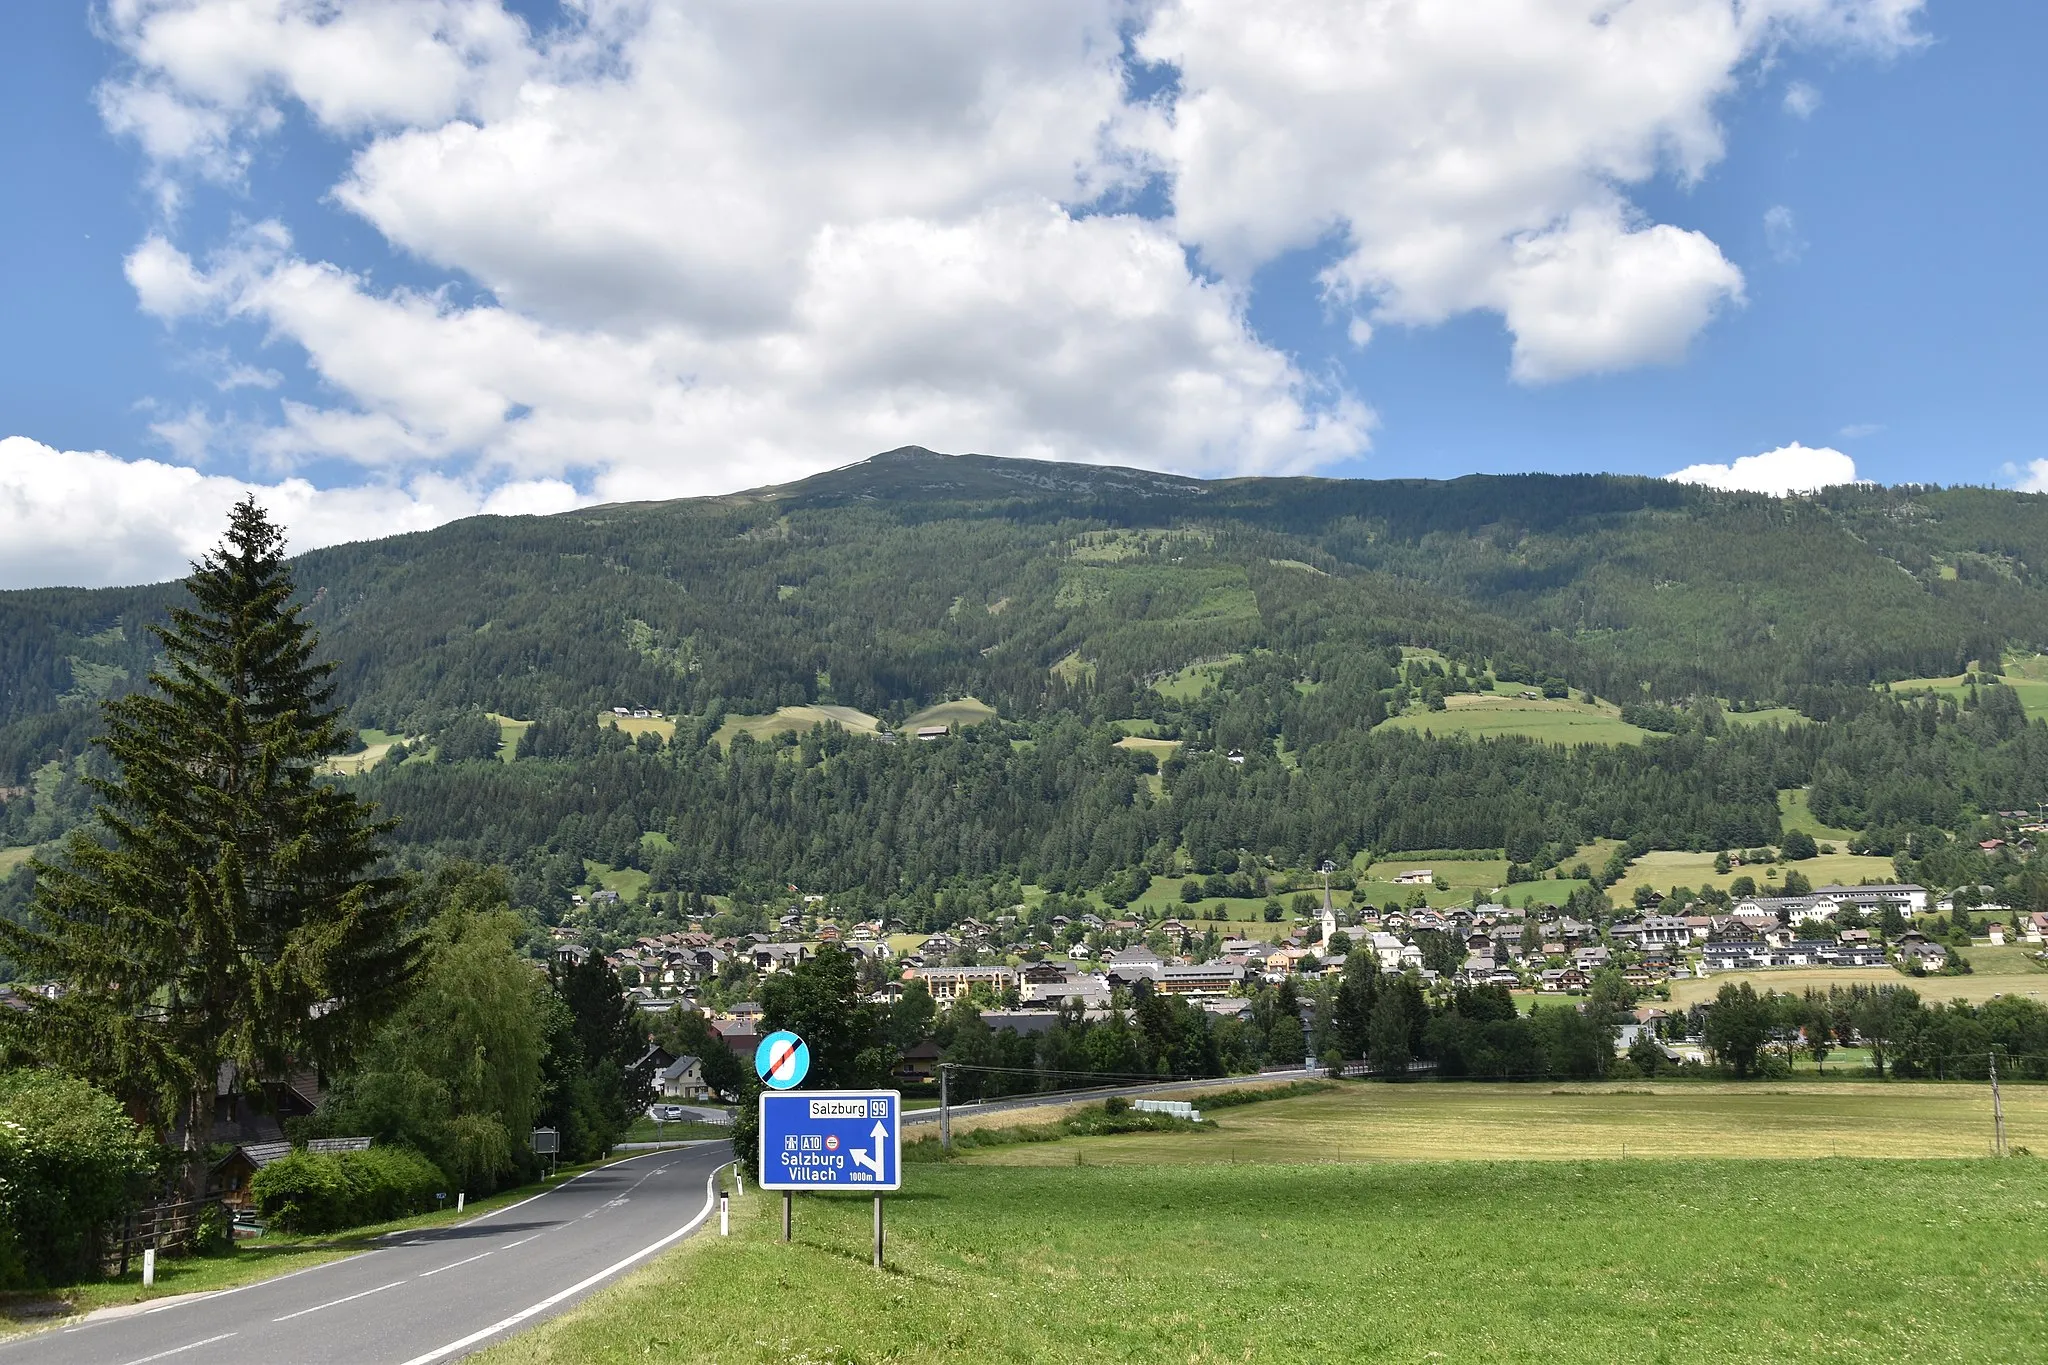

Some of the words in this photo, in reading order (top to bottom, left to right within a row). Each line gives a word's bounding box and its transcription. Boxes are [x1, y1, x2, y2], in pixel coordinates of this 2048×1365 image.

[812, 1103, 865, 1117] Salzburg
[873, 1101, 886, 1116] 99
[803, 1137, 820, 1149] A10
[781, 1152, 844, 1169] Salzburg
[789, 1167, 837, 1181] Villach
